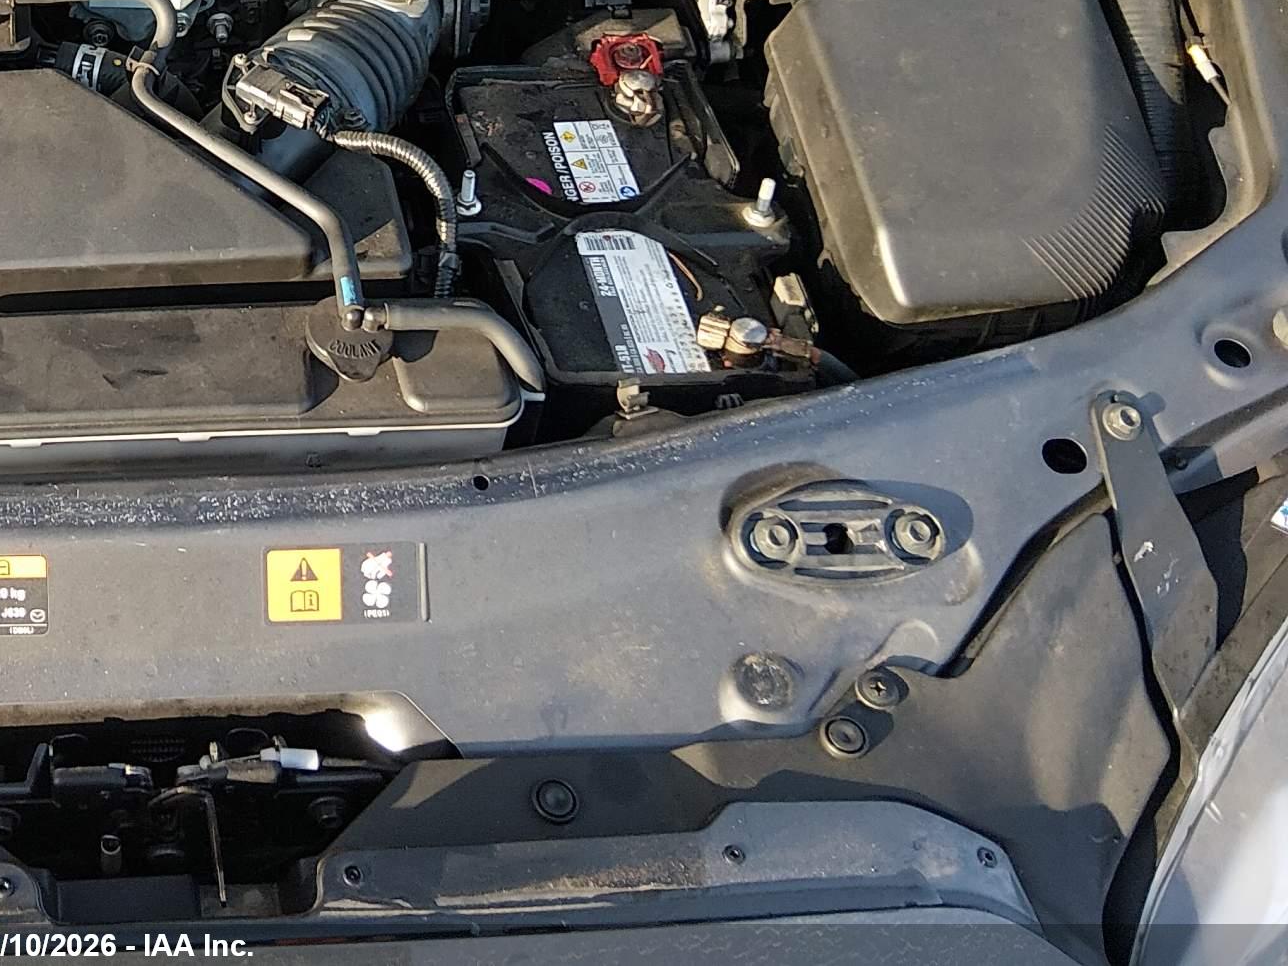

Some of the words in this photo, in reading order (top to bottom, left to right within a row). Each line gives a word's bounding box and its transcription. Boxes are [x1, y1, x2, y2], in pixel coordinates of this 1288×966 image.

[559, 175, 581, 202] NGER
[329, 339, 383, 359] COOLANT
[9, 586, 26, 602] kg
